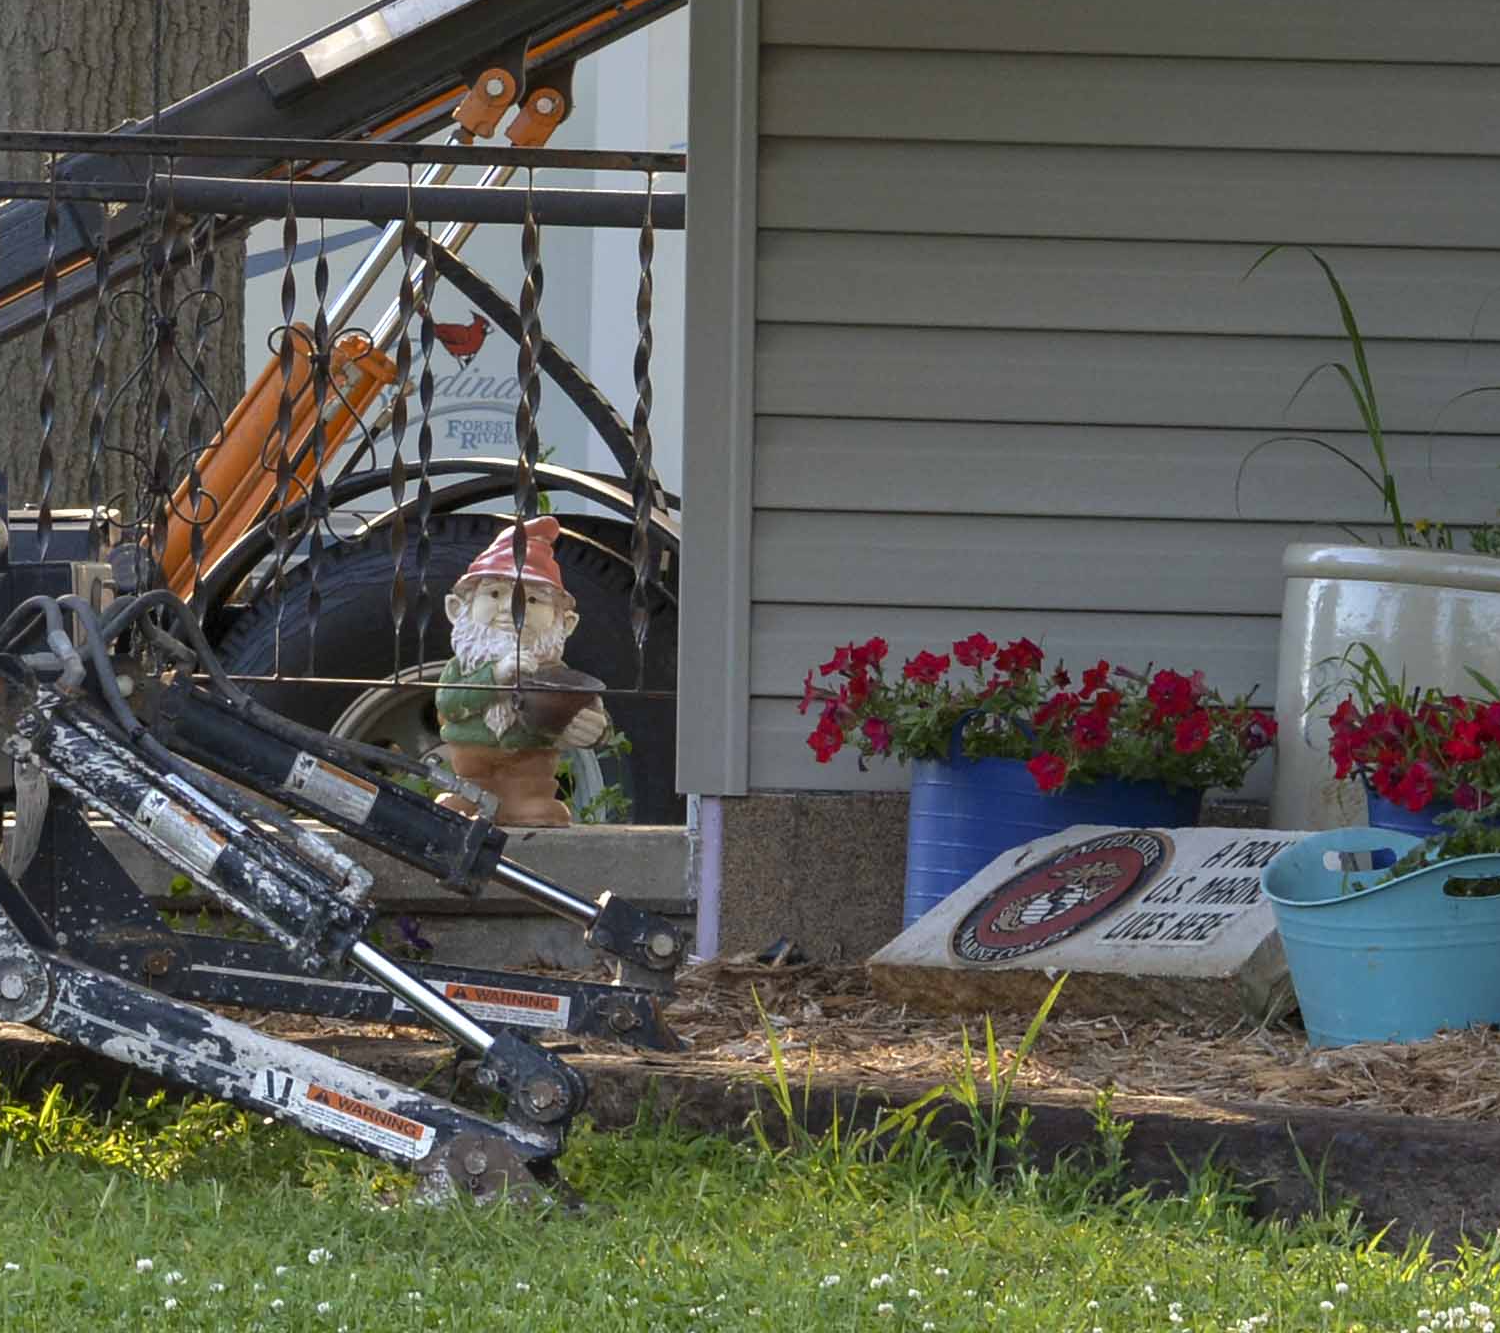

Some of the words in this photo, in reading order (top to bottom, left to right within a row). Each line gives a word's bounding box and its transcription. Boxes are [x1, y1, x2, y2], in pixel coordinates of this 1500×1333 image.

[446, 419, 513, 438] FOREST
[460, 433, 514, 449] RIVER
[1200, 840, 1238, 868] A
[1221, 840, 1297, 868] PROU
[1141, 876, 1198, 904] U.S.
[1102, 910, 1178, 941] LIVES
[1158, 911, 1235, 941] HERE
[475, 988, 554, 1010] WARNING
[337, 1095, 416, 1135] WARNING
